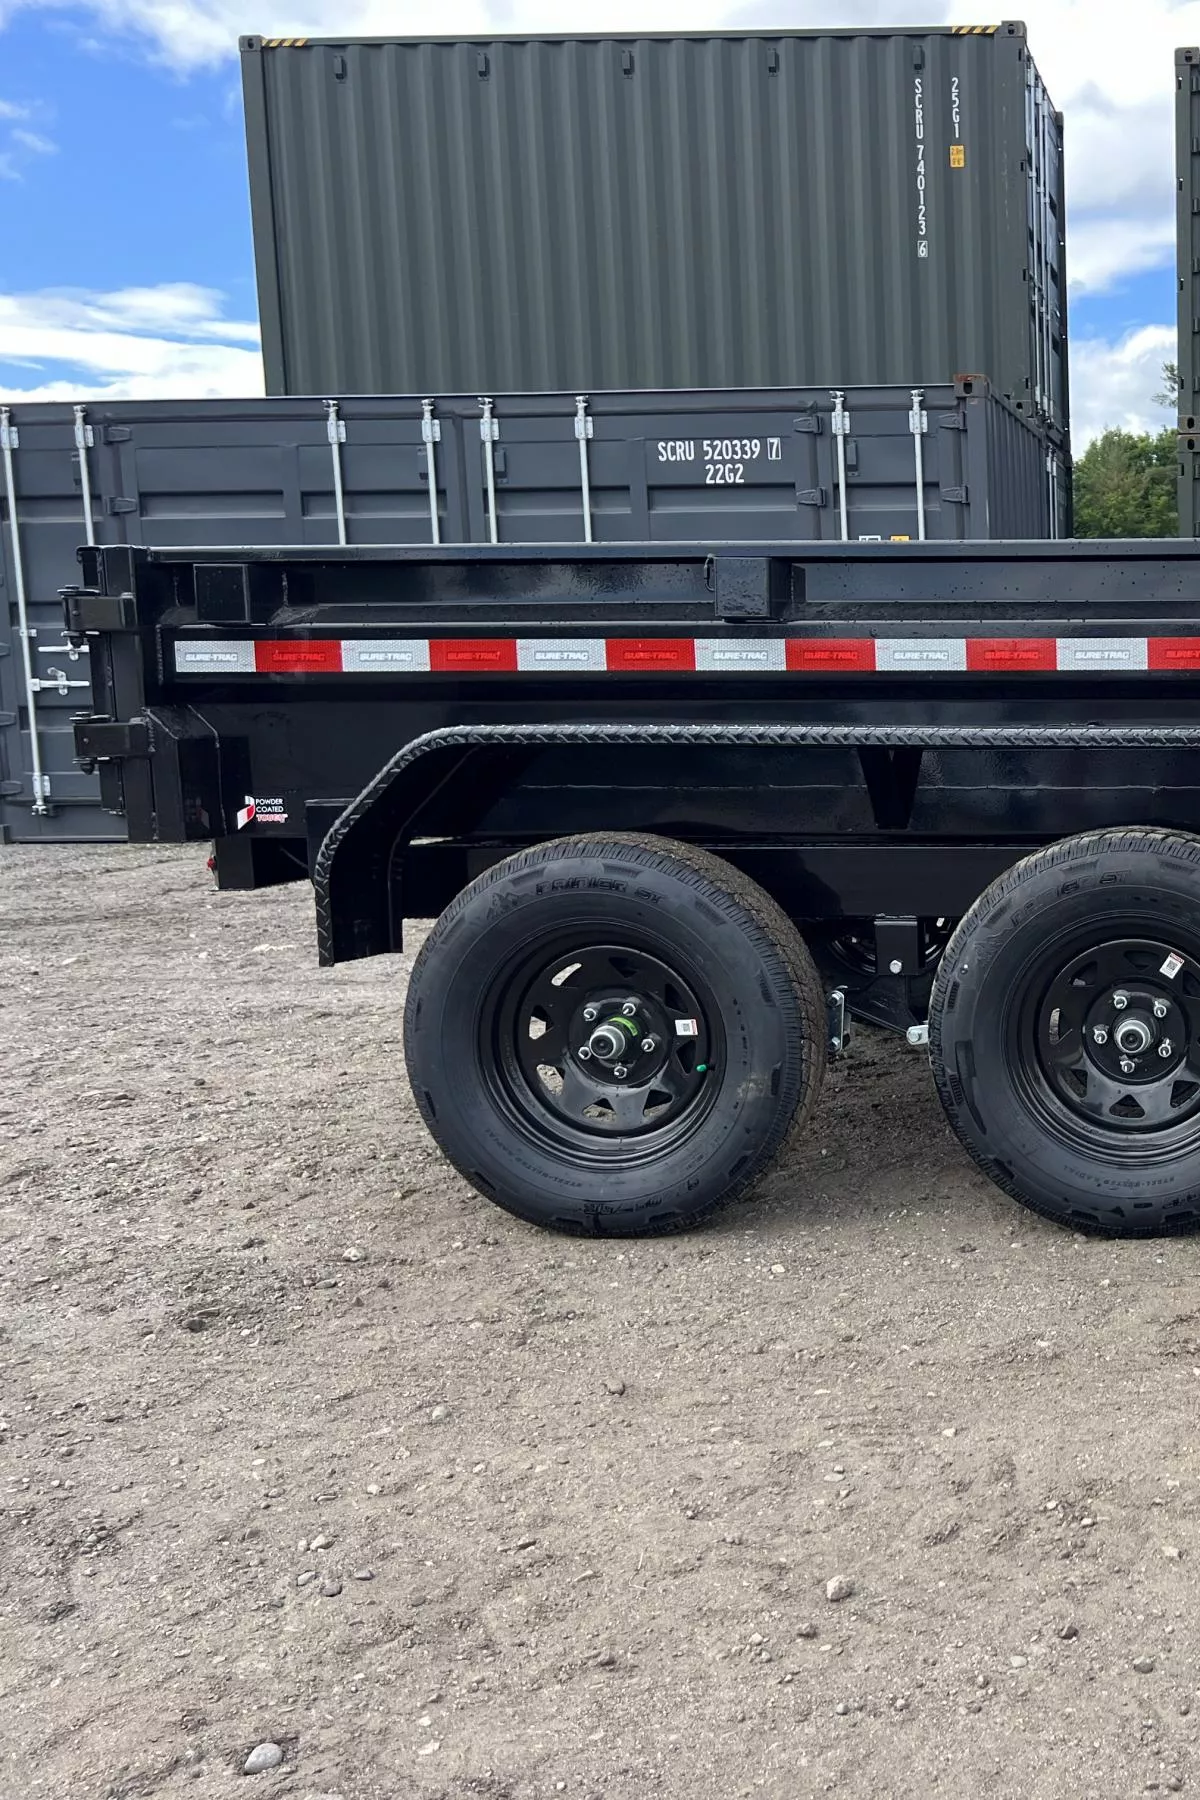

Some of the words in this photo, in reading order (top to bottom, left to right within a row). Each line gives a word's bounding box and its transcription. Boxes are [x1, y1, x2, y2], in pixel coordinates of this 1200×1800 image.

[915, 78, 924, 139] SCRU
[951, 77, 960, 138] 25G1
[917, 145, 926, 236] 740123
[918, 241, 928, 257] 6
[658, 441, 695, 461] SCRU
[702, 439, 761, 460] 520339
[768, 438, 780, 459] 7
[705, 463, 745, 484] 22G2
[185, 653, 238, 661] SURE-TRAC
[272, 652, 325, 661] SURE-TRAC
[360, 652, 412, 661] SURE-TRAC
[447, 652, 500, 660] SURE-TRAC
[535, 652, 588, 660] SURE-TRAC
[624, 652, 678, 660] SURE-TRAC
[713, 652, 768, 660] SURE-TRAC
[804, 651, 858, 660] SURE-TRAC
[894, 652, 949, 660] SURE-TRAC
[984, 651, 1040, 660] SURE-TRAC
[1074, 651, 1129, 660] SURE-TRAC
